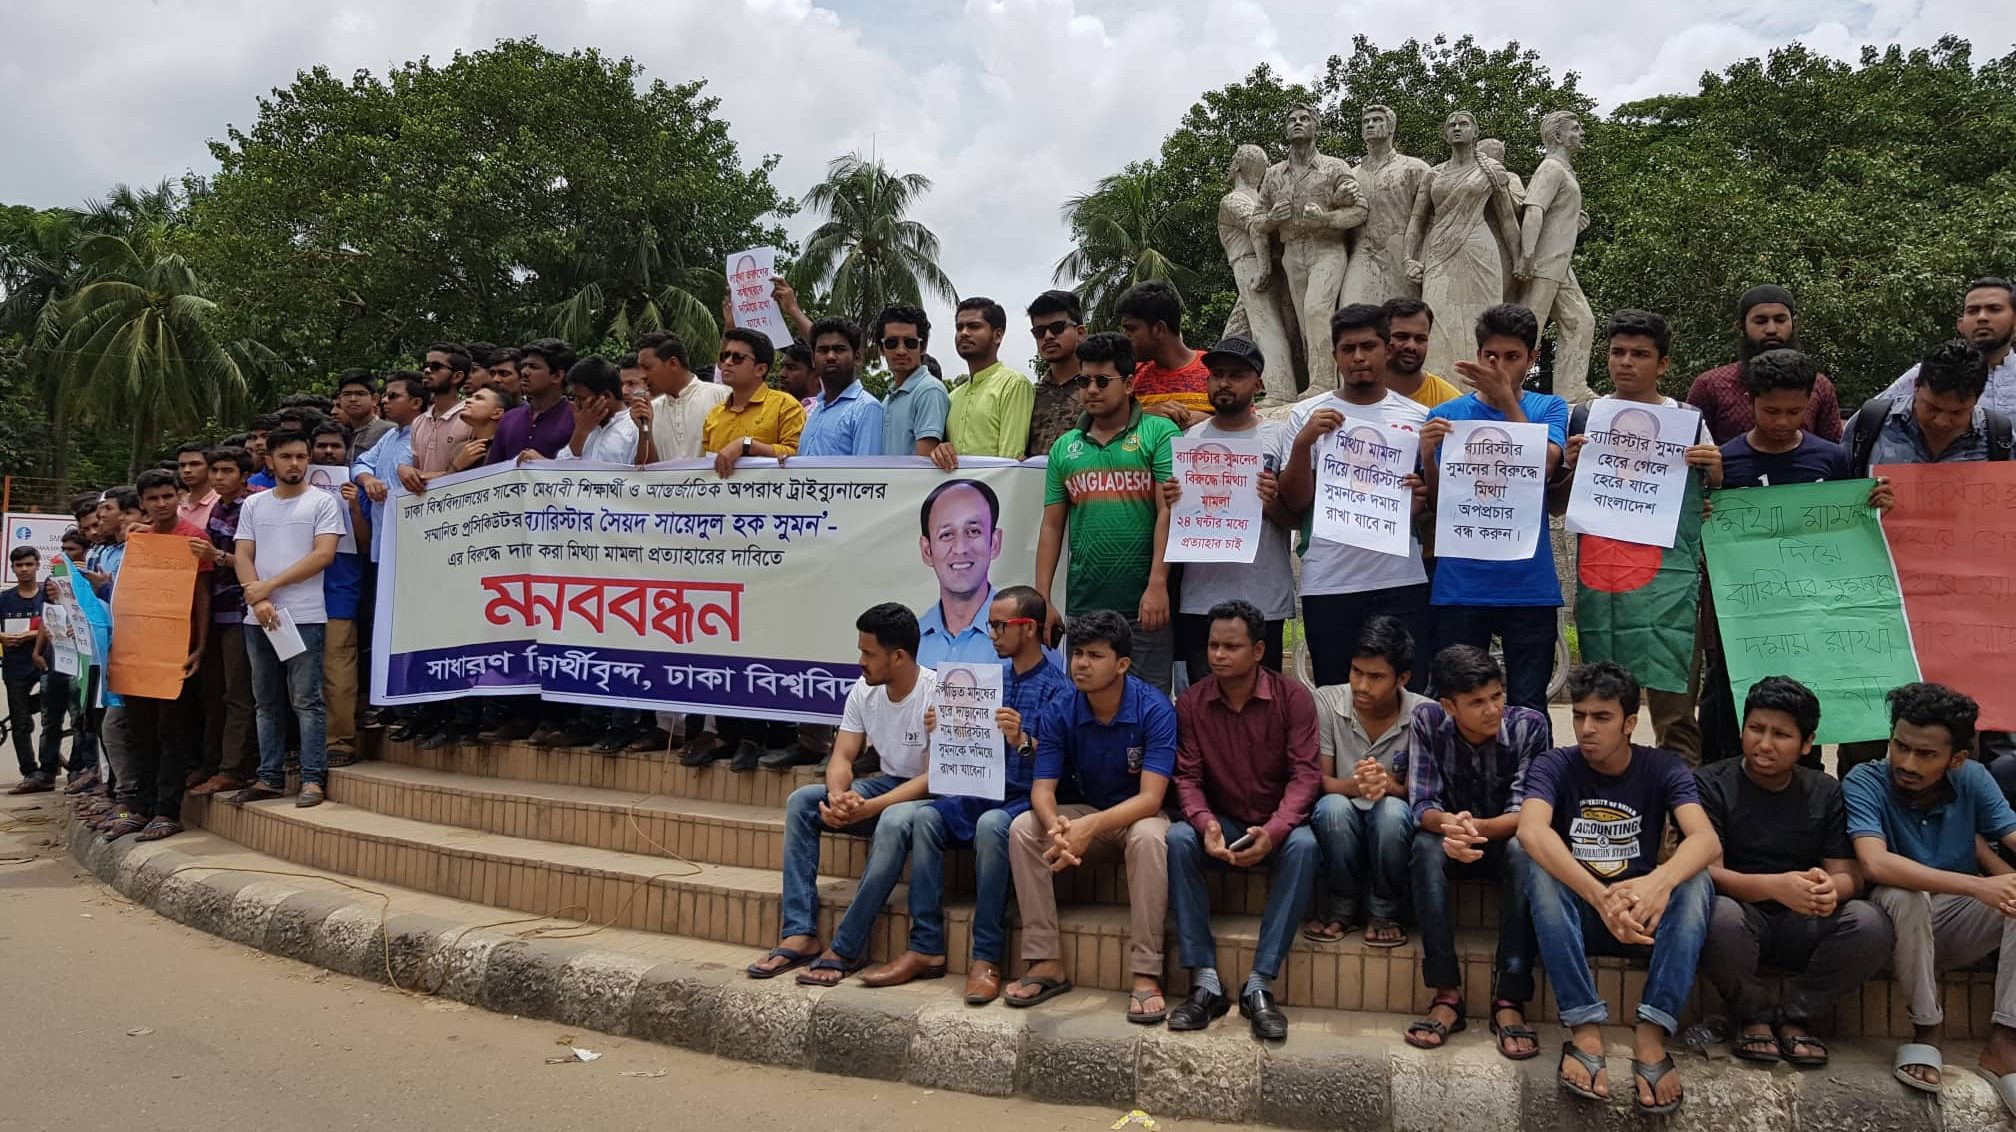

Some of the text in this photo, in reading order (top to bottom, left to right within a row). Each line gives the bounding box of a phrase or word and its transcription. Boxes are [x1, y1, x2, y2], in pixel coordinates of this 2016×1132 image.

[1335, 430, 1403, 466] মিথ্যা মামলা
[1464, 438, 1524, 456] ব্যারিস্টার
[1590, 429, 1688, 459] ব্যারিস্টার সুমন
[1175, 448, 1258, 468] ব্যারিস্টার সুমনের
[1598, 453, 1669, 477] হেরে গেলে
[1184, 470, 1248, 487] বিরুদ্ধে মিথ্যা
[1323, 453, 1406, 490] দিয়ে ব্যারিস্টার
[1446, 460, 1540, 479] সুমনের বিরুদ্ধে
[1473, 480, 1507, 499] মিথ্যা
[1593, 472, 1660, 495] হেরে যাবে
[404, 502, 424, 520] ঢাকা
[426, 488, 490, 517] বিশ্ববিদ্যালয়ের
[532, 478, 575, 499] মেধাবী
[577, 477, 628, 499] শিক্ষার্থী
[629, 483, 641, 498] ও
[646, 477, 723, 499] আন্তর্জাতিক
[727, 481, 785, 499] অপরাধ
[1200, 495, 1231, 508] মামলা
[1324, 483, 1367, 505] সুমনকে
[1459, 504, 1515, 520] অপপ্রচার
[1593, 492, 1657, 516] বাংলাদেশ
[524, 504, 595, 532] ব্যারিস্টার
[600, 505, 650, 534] সৈয়দ
[654, 511, 726, 541] সায়েদুল
[731, 513, 767, 539] হক
[1177, 516, 1191, 528] ২৪
[1226, 519, 1249, 531] মধ্যে
[1325, 505, 1398, 536] রাখা যাবে না
[1454, 524, 1475, 540] বন্ধ
[447, 552, 464, 568] এর
[467, 545, 502, 566] বিরুদ্ধে
[537, 543, 564, 561] করা
[567, 539, 600, 563] মিথ্যা
[604, 544, 644, 563] মামলা
[648, 546, 725, 567] প্রত্যাহারের
[731, 544, 785, 567] দাবিতে
[1181, 538, 1243, 551] প্রত্যাহার চাই
[426, 649, 514, 681] সাধারণ
[662, 663, 736, 693] ঢাকা
[967, 686, 997, 702] মানুষের
[940, 722, 992, 740] নাম ব্যারিস্টার
[938, 742, 993, 759] সুমনকে দমিয়ে
[940, 762, 958, 775] রাখা
